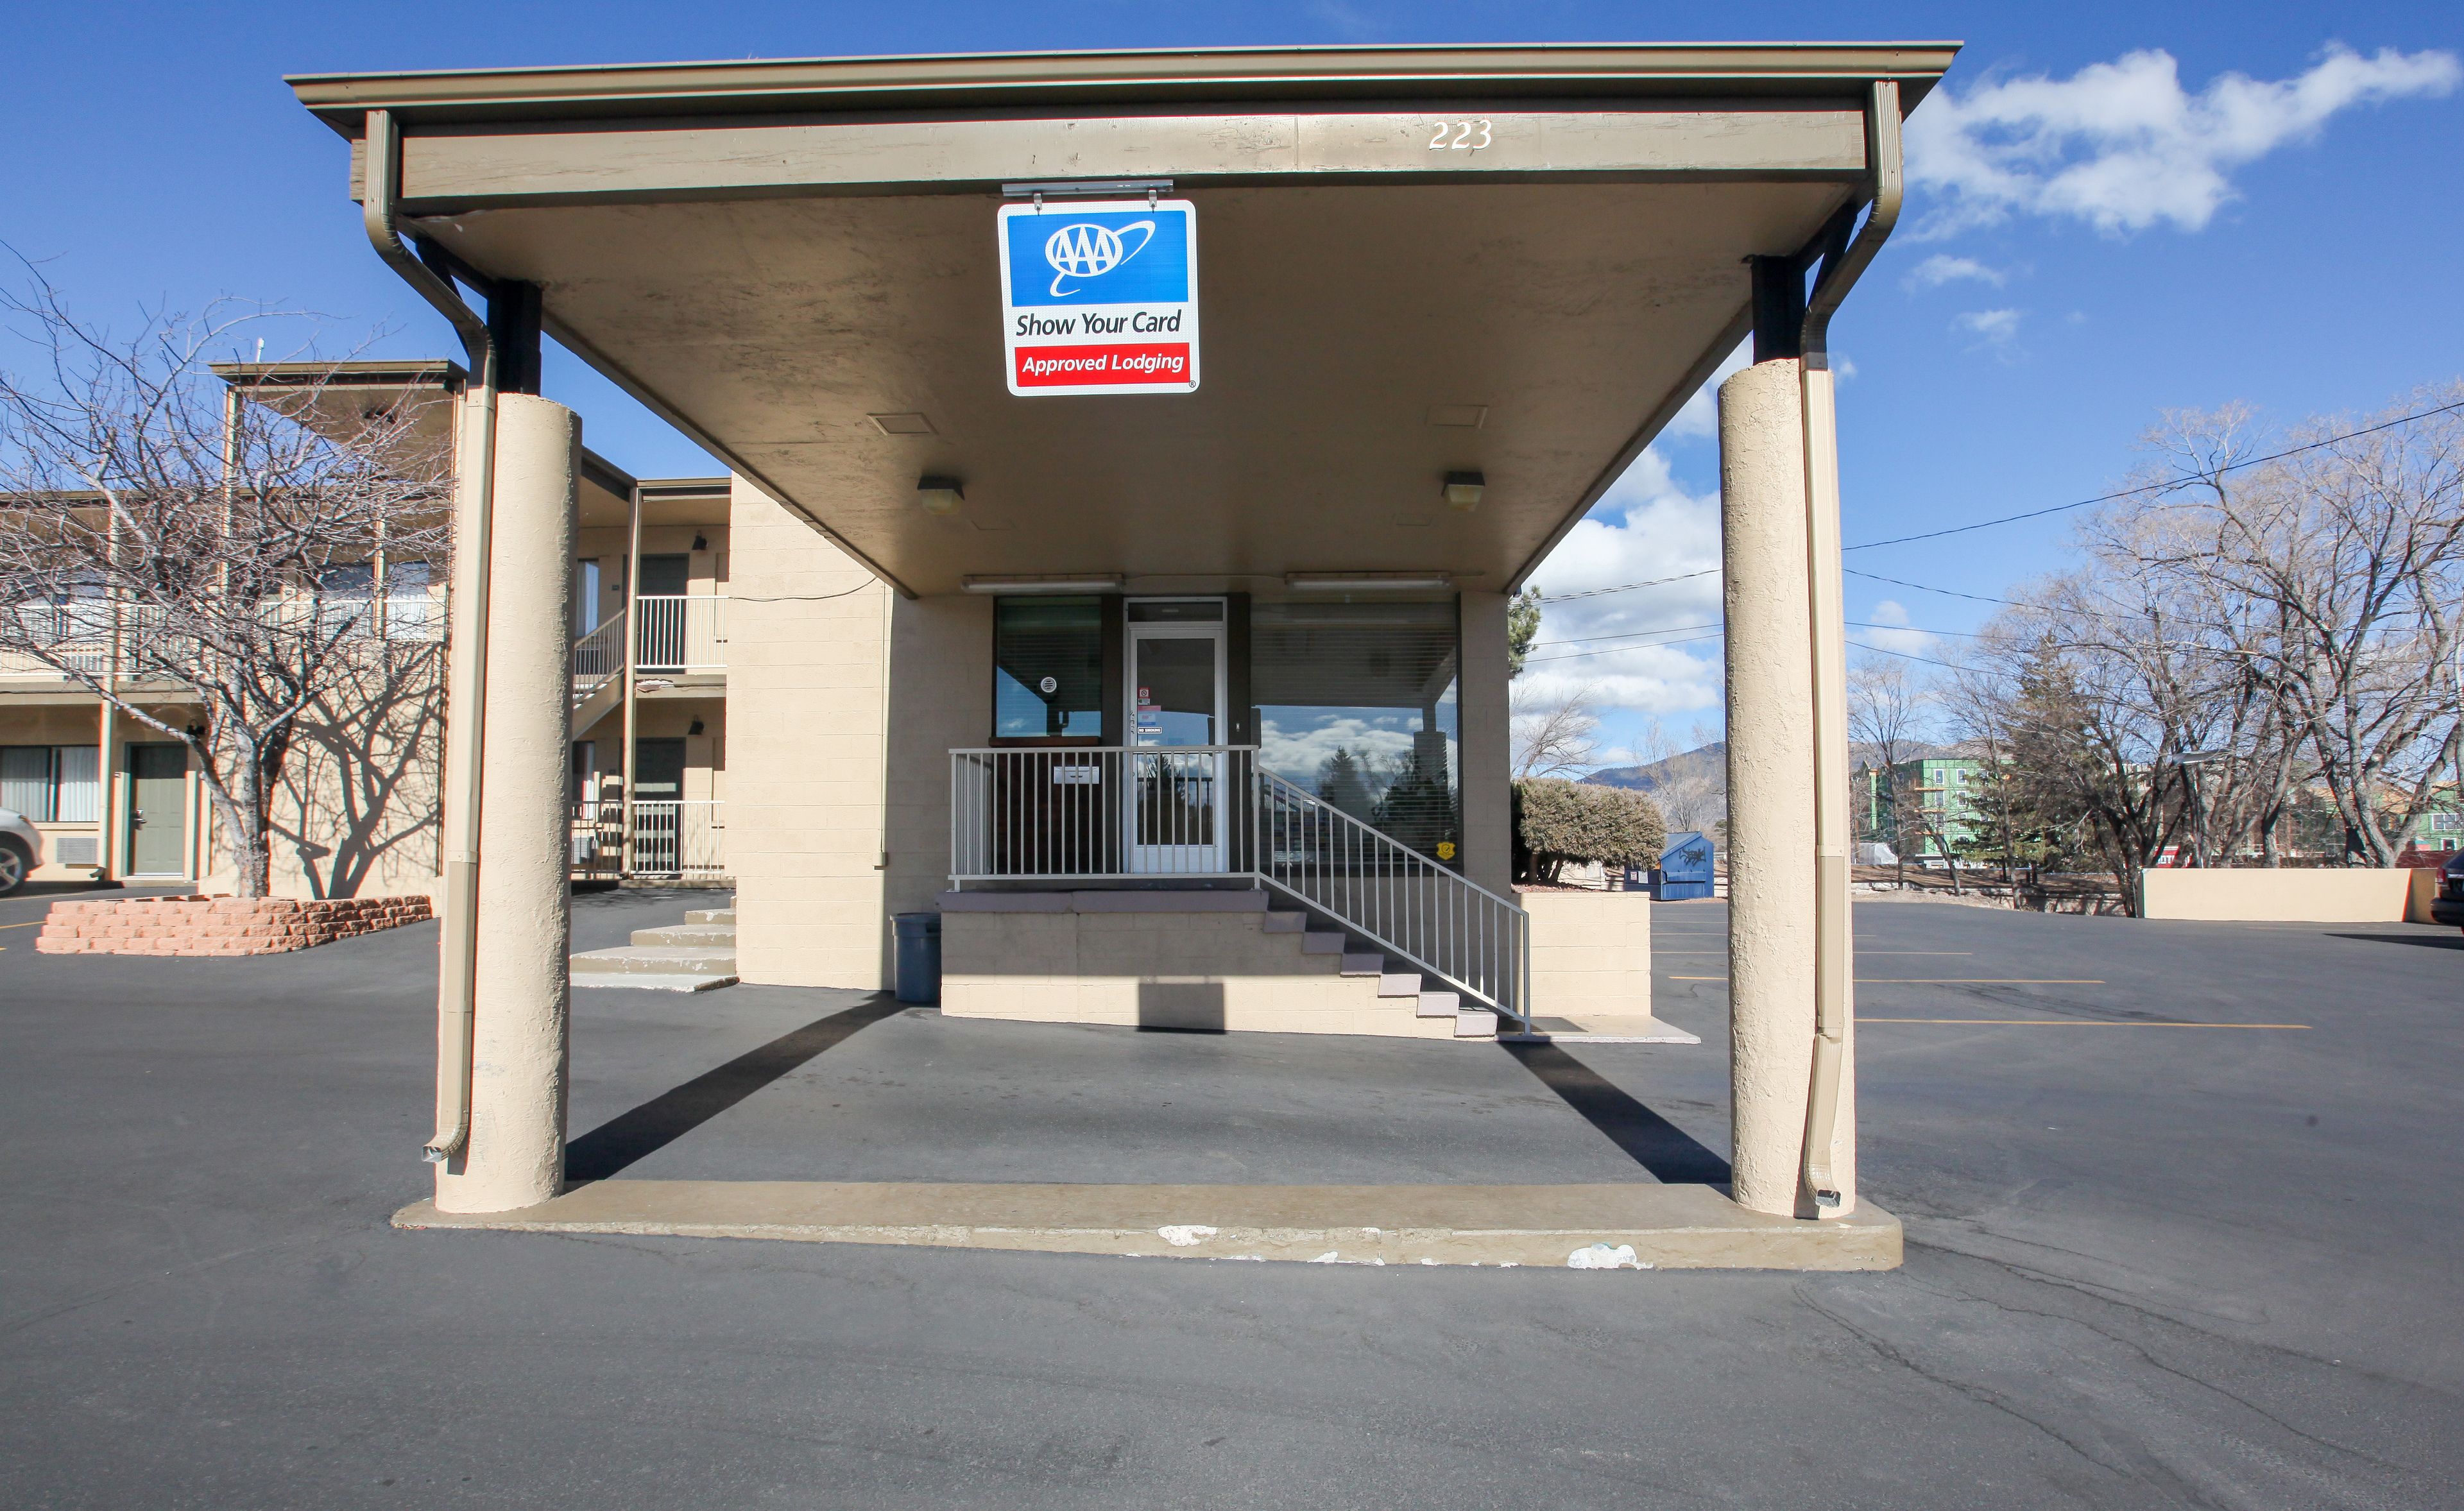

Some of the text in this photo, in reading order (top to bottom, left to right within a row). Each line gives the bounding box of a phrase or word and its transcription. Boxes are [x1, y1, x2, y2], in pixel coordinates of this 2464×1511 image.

[1429, 119, 1491, 151] 223
[1053, 225, 1117, 276] AAA
[1016, 309, 1182, 336] Show Your Card
[1022, 354, 1184, 376] Approved Lodging
